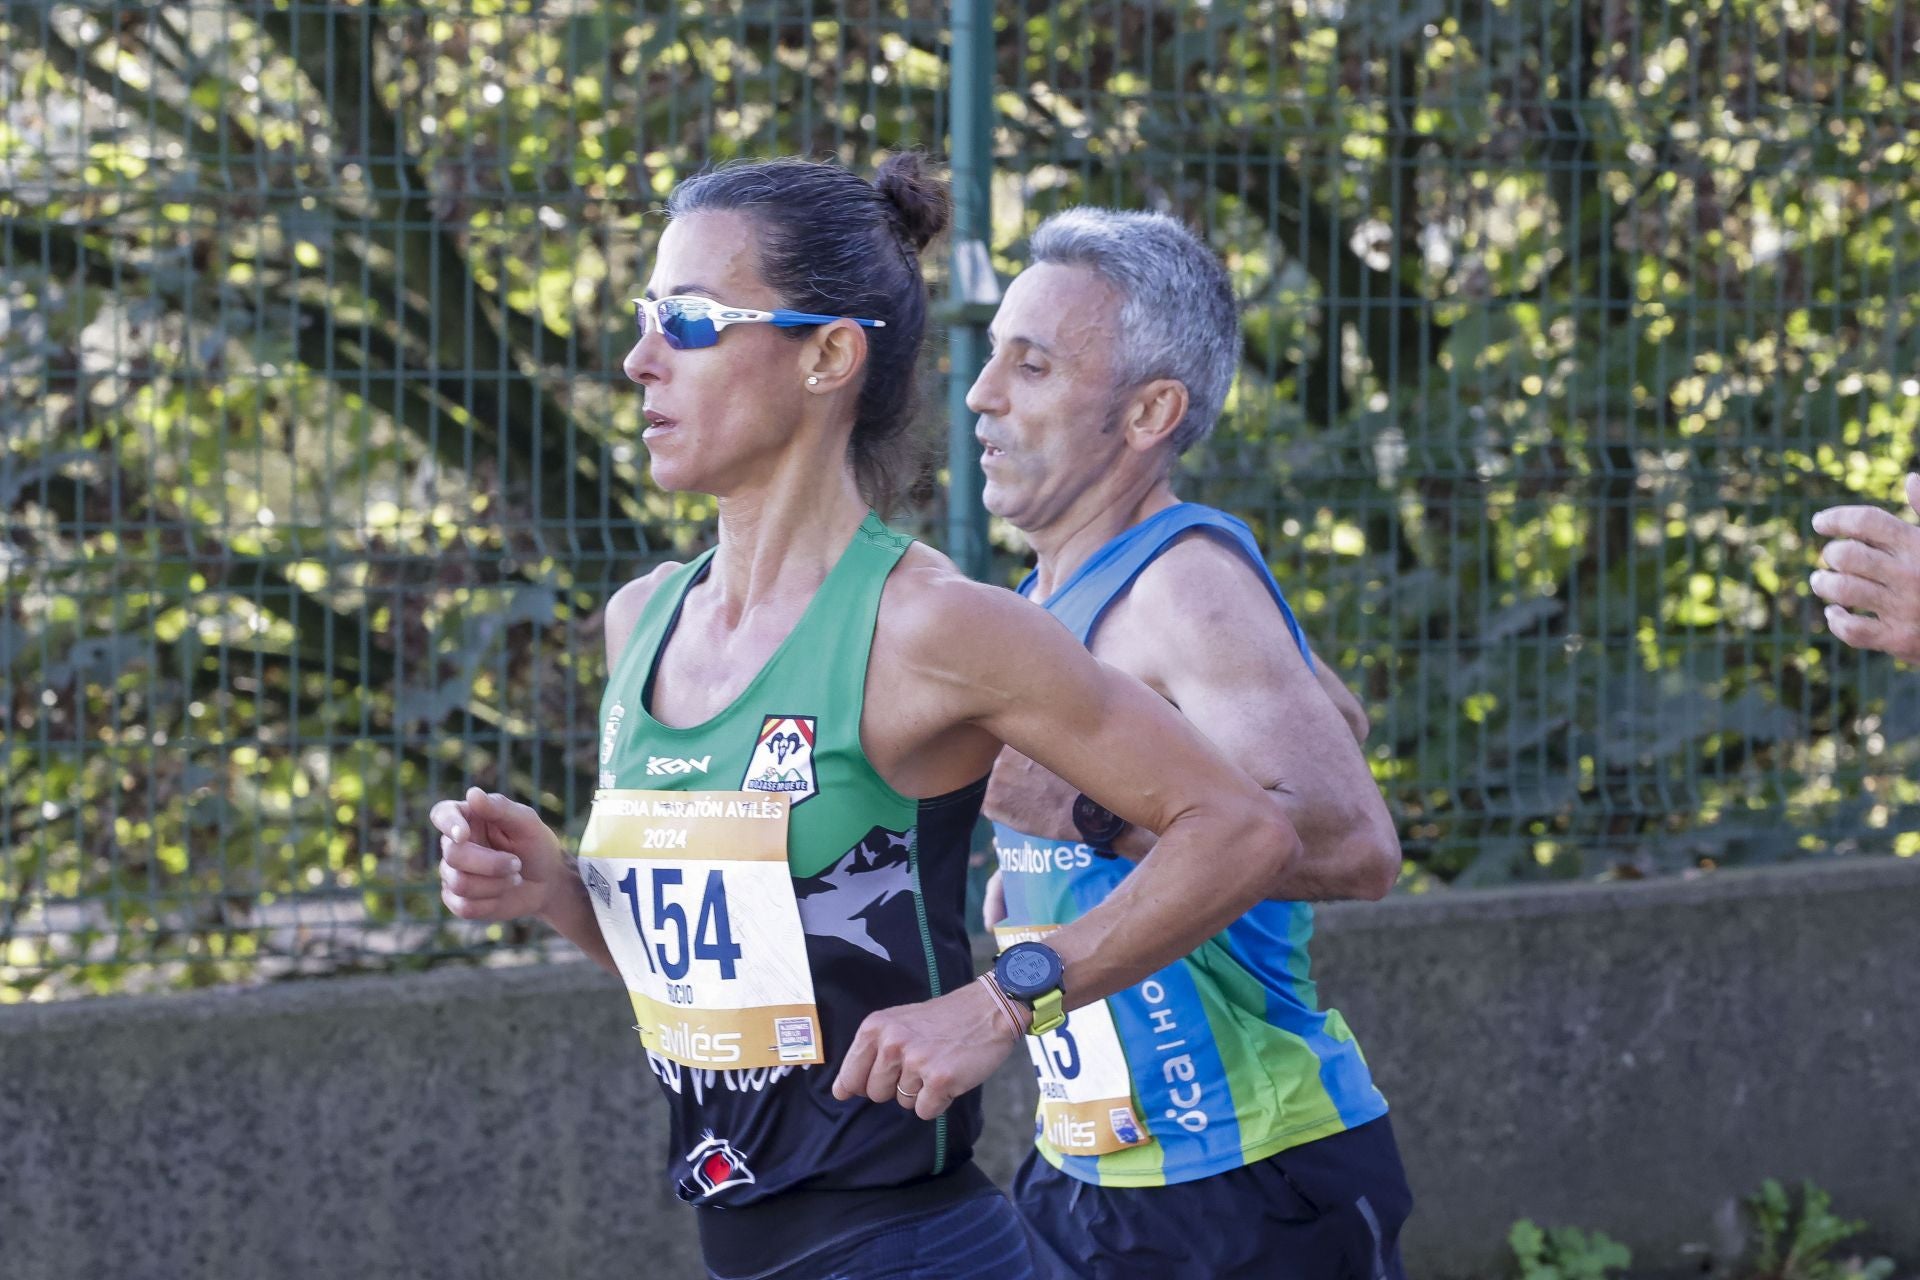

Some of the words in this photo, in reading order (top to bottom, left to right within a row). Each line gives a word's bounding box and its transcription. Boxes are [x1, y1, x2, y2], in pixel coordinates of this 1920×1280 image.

[652, 797, 723, 817] MARATÓN
[726, 796, 783, 819] AVILÉS
[641, 828, 688, 849] 2024
[617, 867, 742, 980] 154
[658, 1022, 742, 1062] avilés
[1047, 1113, 1096, 1148] vilés
